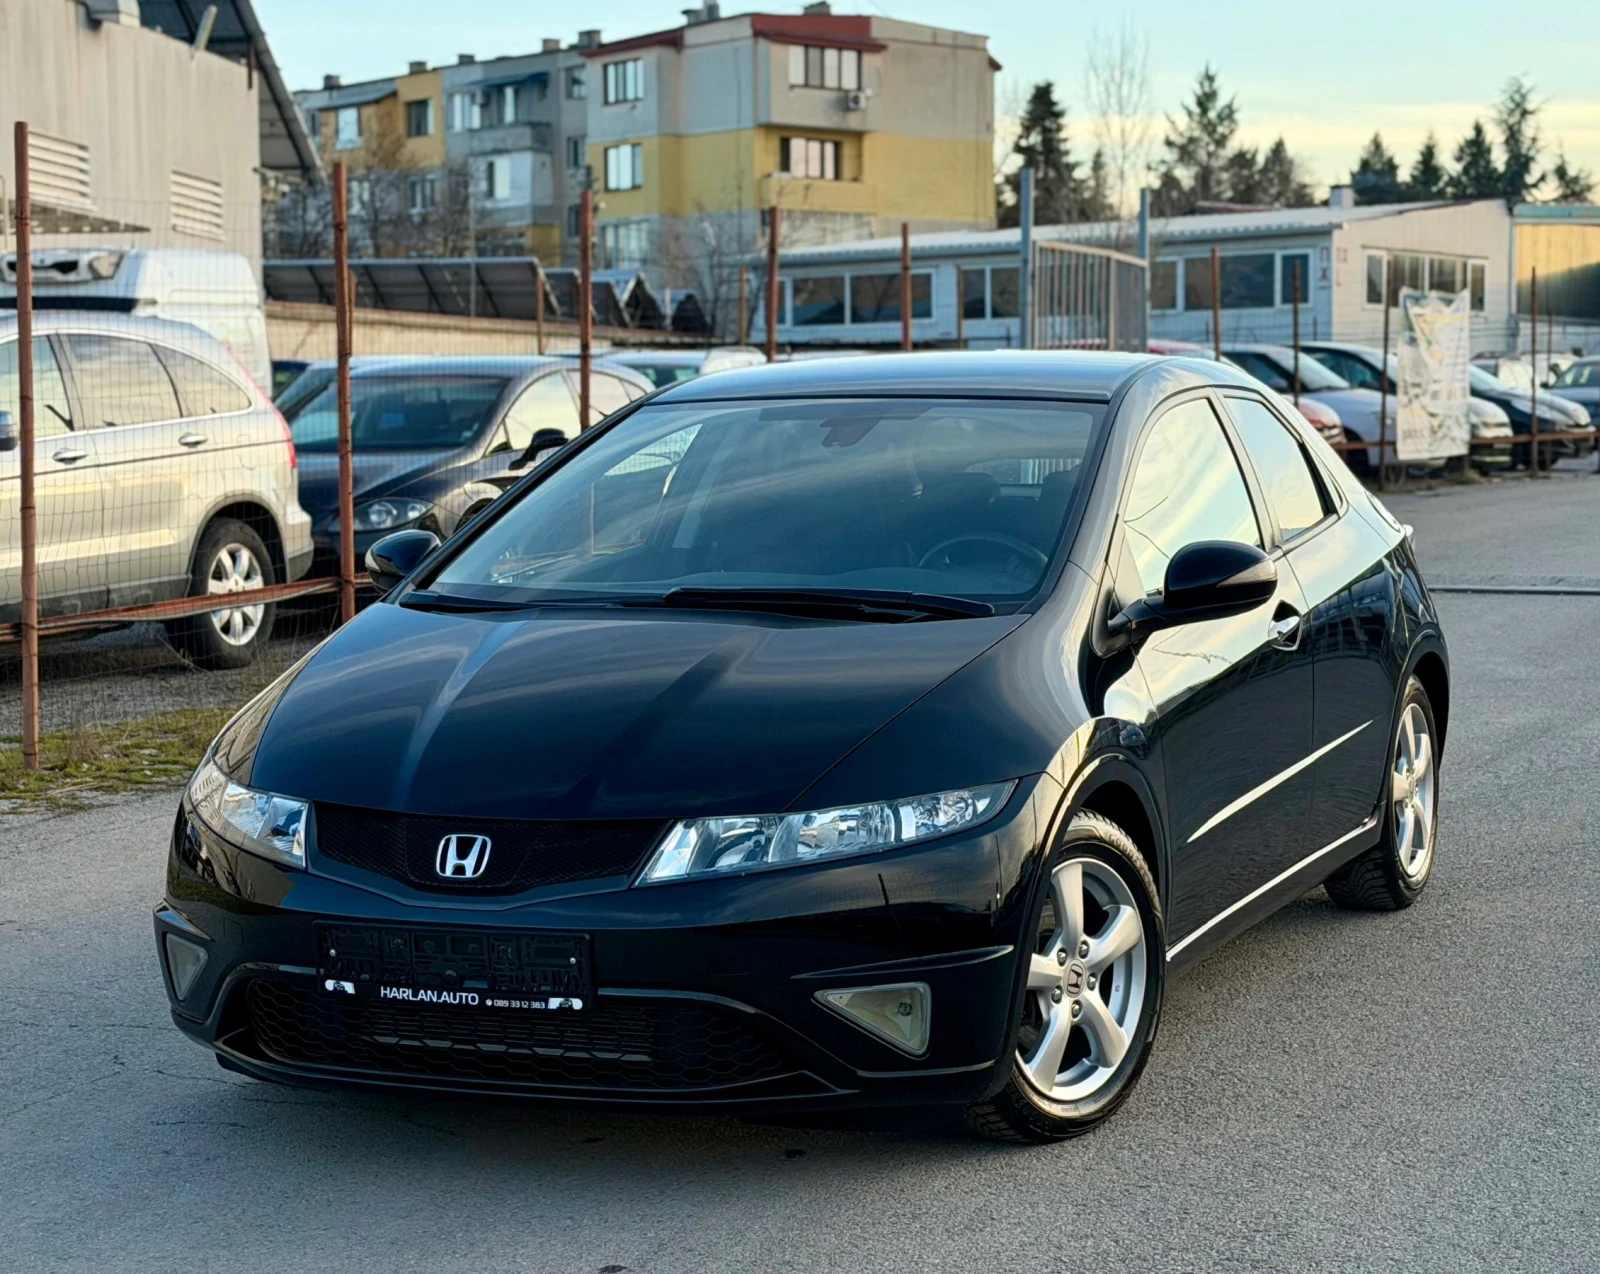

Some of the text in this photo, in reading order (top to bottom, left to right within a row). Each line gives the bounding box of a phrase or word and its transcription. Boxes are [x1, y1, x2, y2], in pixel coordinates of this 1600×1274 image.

[380, 985, 479, 1006] HARLAN.AUTO
[493, 999, 546, 1010] 089 33 12 383
